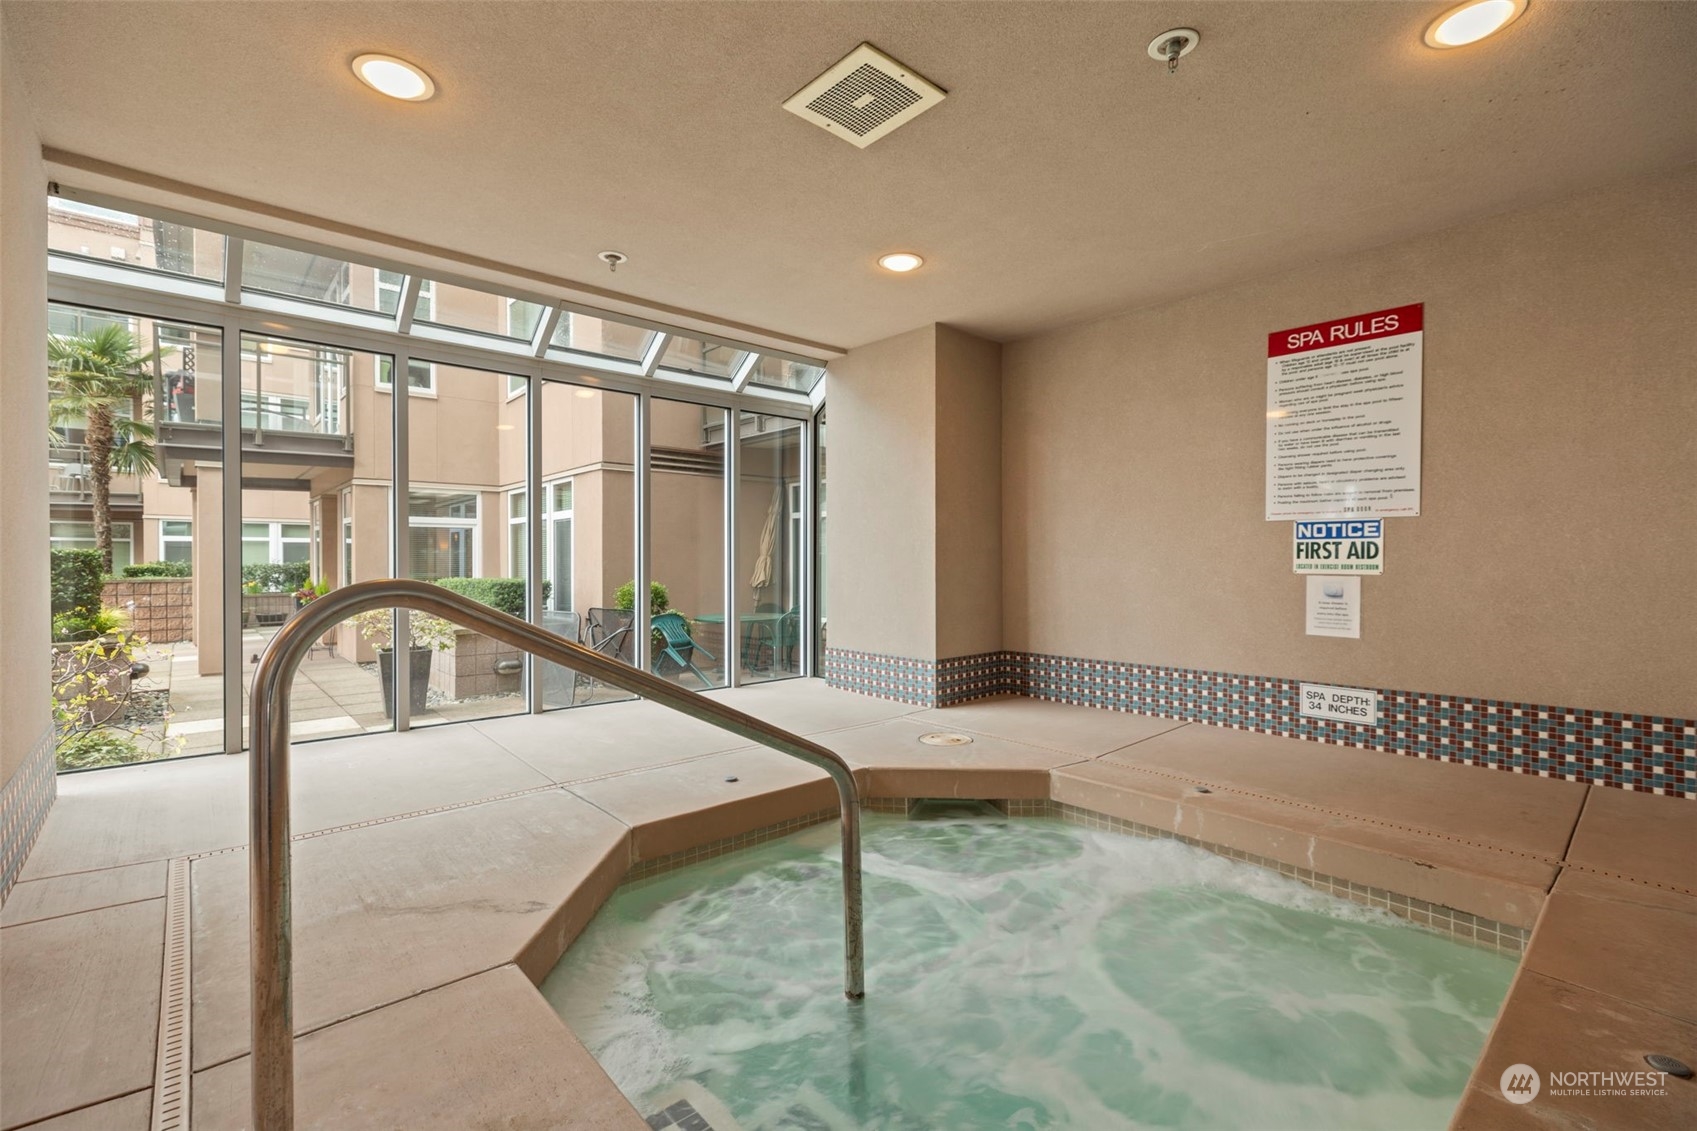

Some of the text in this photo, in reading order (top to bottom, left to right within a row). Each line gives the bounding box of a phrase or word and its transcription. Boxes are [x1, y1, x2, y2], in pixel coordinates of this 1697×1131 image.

[1287, 314, 1399, 349] SPA RULES
[1298, 522, 1379, 538] NOTICE
[1296, 542, 1379, 560] FIRST AID
[1306, 691, 1370, 706] SPA DEPTH:
[1309, 702, 1368, 716] 34 INCHES
